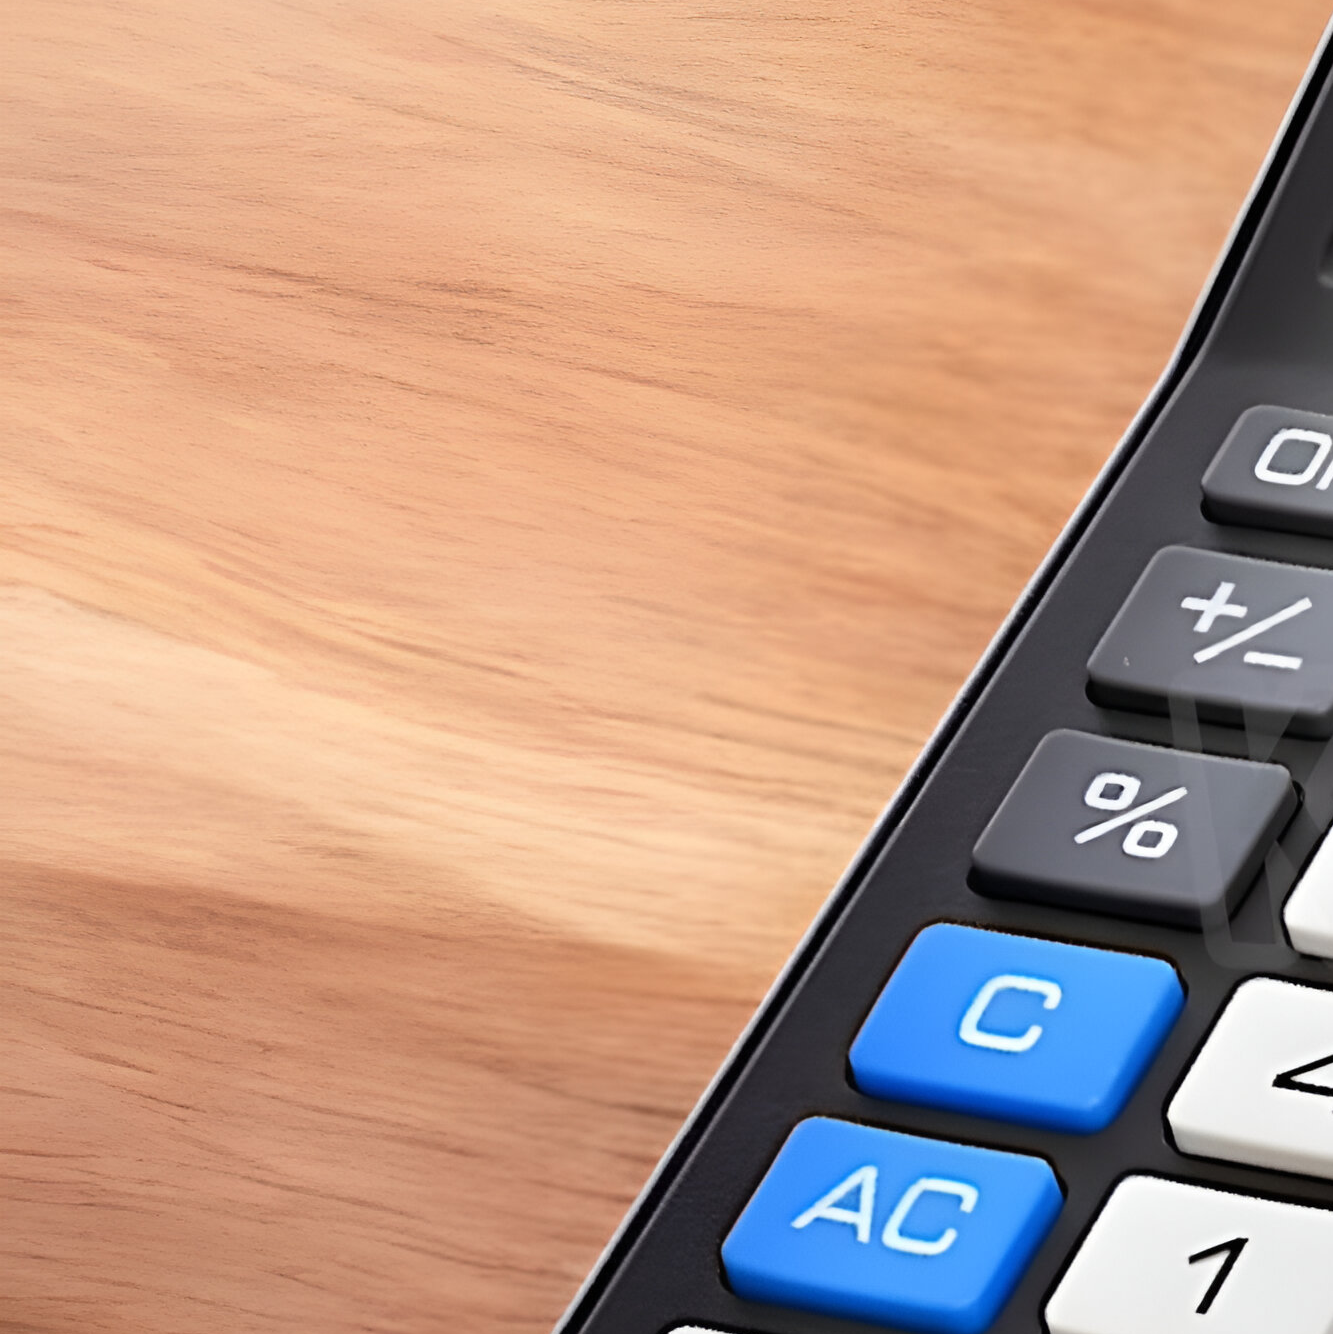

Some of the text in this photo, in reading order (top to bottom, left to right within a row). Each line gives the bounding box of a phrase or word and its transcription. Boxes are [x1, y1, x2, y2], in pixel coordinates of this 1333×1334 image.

[1074, 772, 1188, 859] %
[959, 974, 1062, 1052] C
[790, 1164, 982, 1256] AC
[1188, 1237, 1249, 1315] 1
